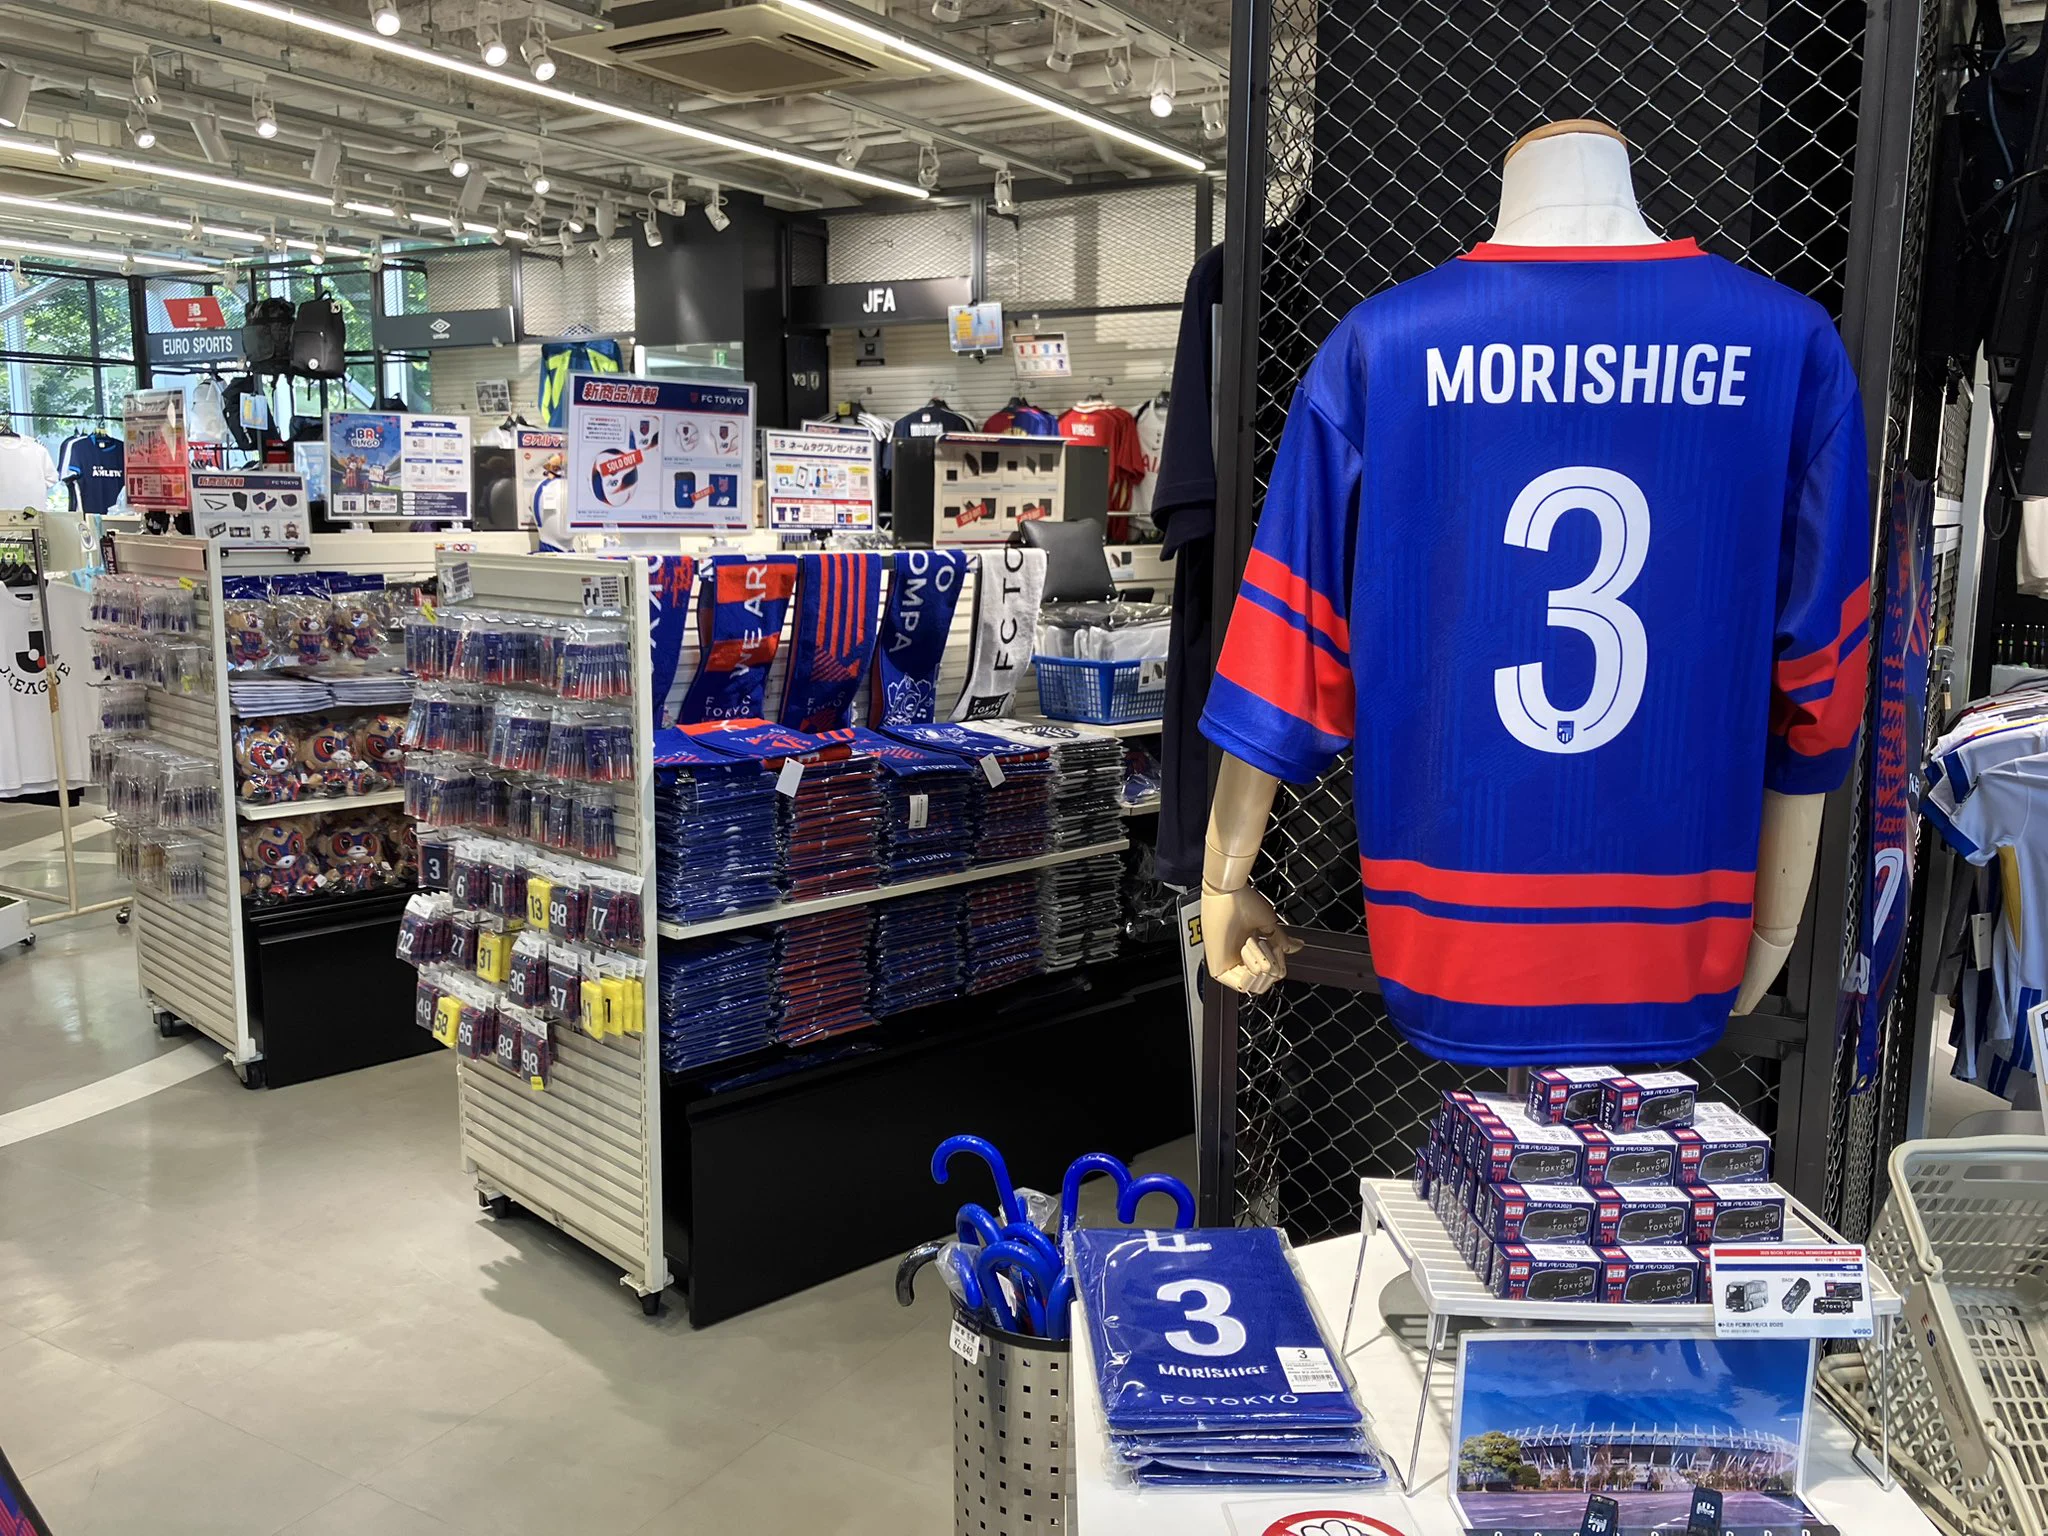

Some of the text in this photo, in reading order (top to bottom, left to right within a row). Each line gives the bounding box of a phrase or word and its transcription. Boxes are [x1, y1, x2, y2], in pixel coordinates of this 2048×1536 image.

[862, 287, 897, 314] JFA
[162, 335, 233, 355] EURO SPORTS
[1425, 342, 1752, 408] MORISHIGE
[582, 381, 660, 406] 新商品情報
[701, 395, 744, 406] FC TOKYO
[356, 427, 375, 440] BR
[1071, 423, 1096, 437] VIRGIL
[351, 439, 380, 448] BINGO
[606, 453, 637, 473] SOLD OUT
[729, 554, 768, 680] WE AR
[1493, 465, 1651, 755] 3
[704, 705, 750, 718] TOKYO
[428, 858, 440, 880] 3
[456, 875, 465, 898] 6
[492, 882, 504, 911] 11
[530, 895, 543, 920] 13
[592, 906, 608, 931] 17
[398, 929, 415, 955] 22
[451, 934, 465, 958] 27
[479, 947, 492, 972] 31
[510, 969, 526, 996] 36
[550, 985, 567, 1011] 37
[416, 998, 432, 1021] 48
[458, 1021, 473, 1046] 66
[522, 1050, 539, 1075] 98
[1663, 1105, 1686, 1117] TOKYO
[1540, 1164, 1565, 1173] TOKYO
[1635, 1164, 1660, 1173] TOKYO
[1729, 1160, 1753, 1170] TOKYO
[1552, 1222, 1577, 1231] TOKYO
[1648, 1222, 1673, 1231] TOKYO
[1744, 1219, 1769, 1228] TOKYO
[1558, 1282, 1584, 1291] TOKYO
[1656, 1283, 1681, 1292] TOKYO
[1156, 1278, 1247, 1357] 3
[1297, 1349, 1308, 1359] 3
[1157, 1363, 1270, 1379] MORISHIGE
[1160, 1393, 1299, 1406] FC TOKYO
